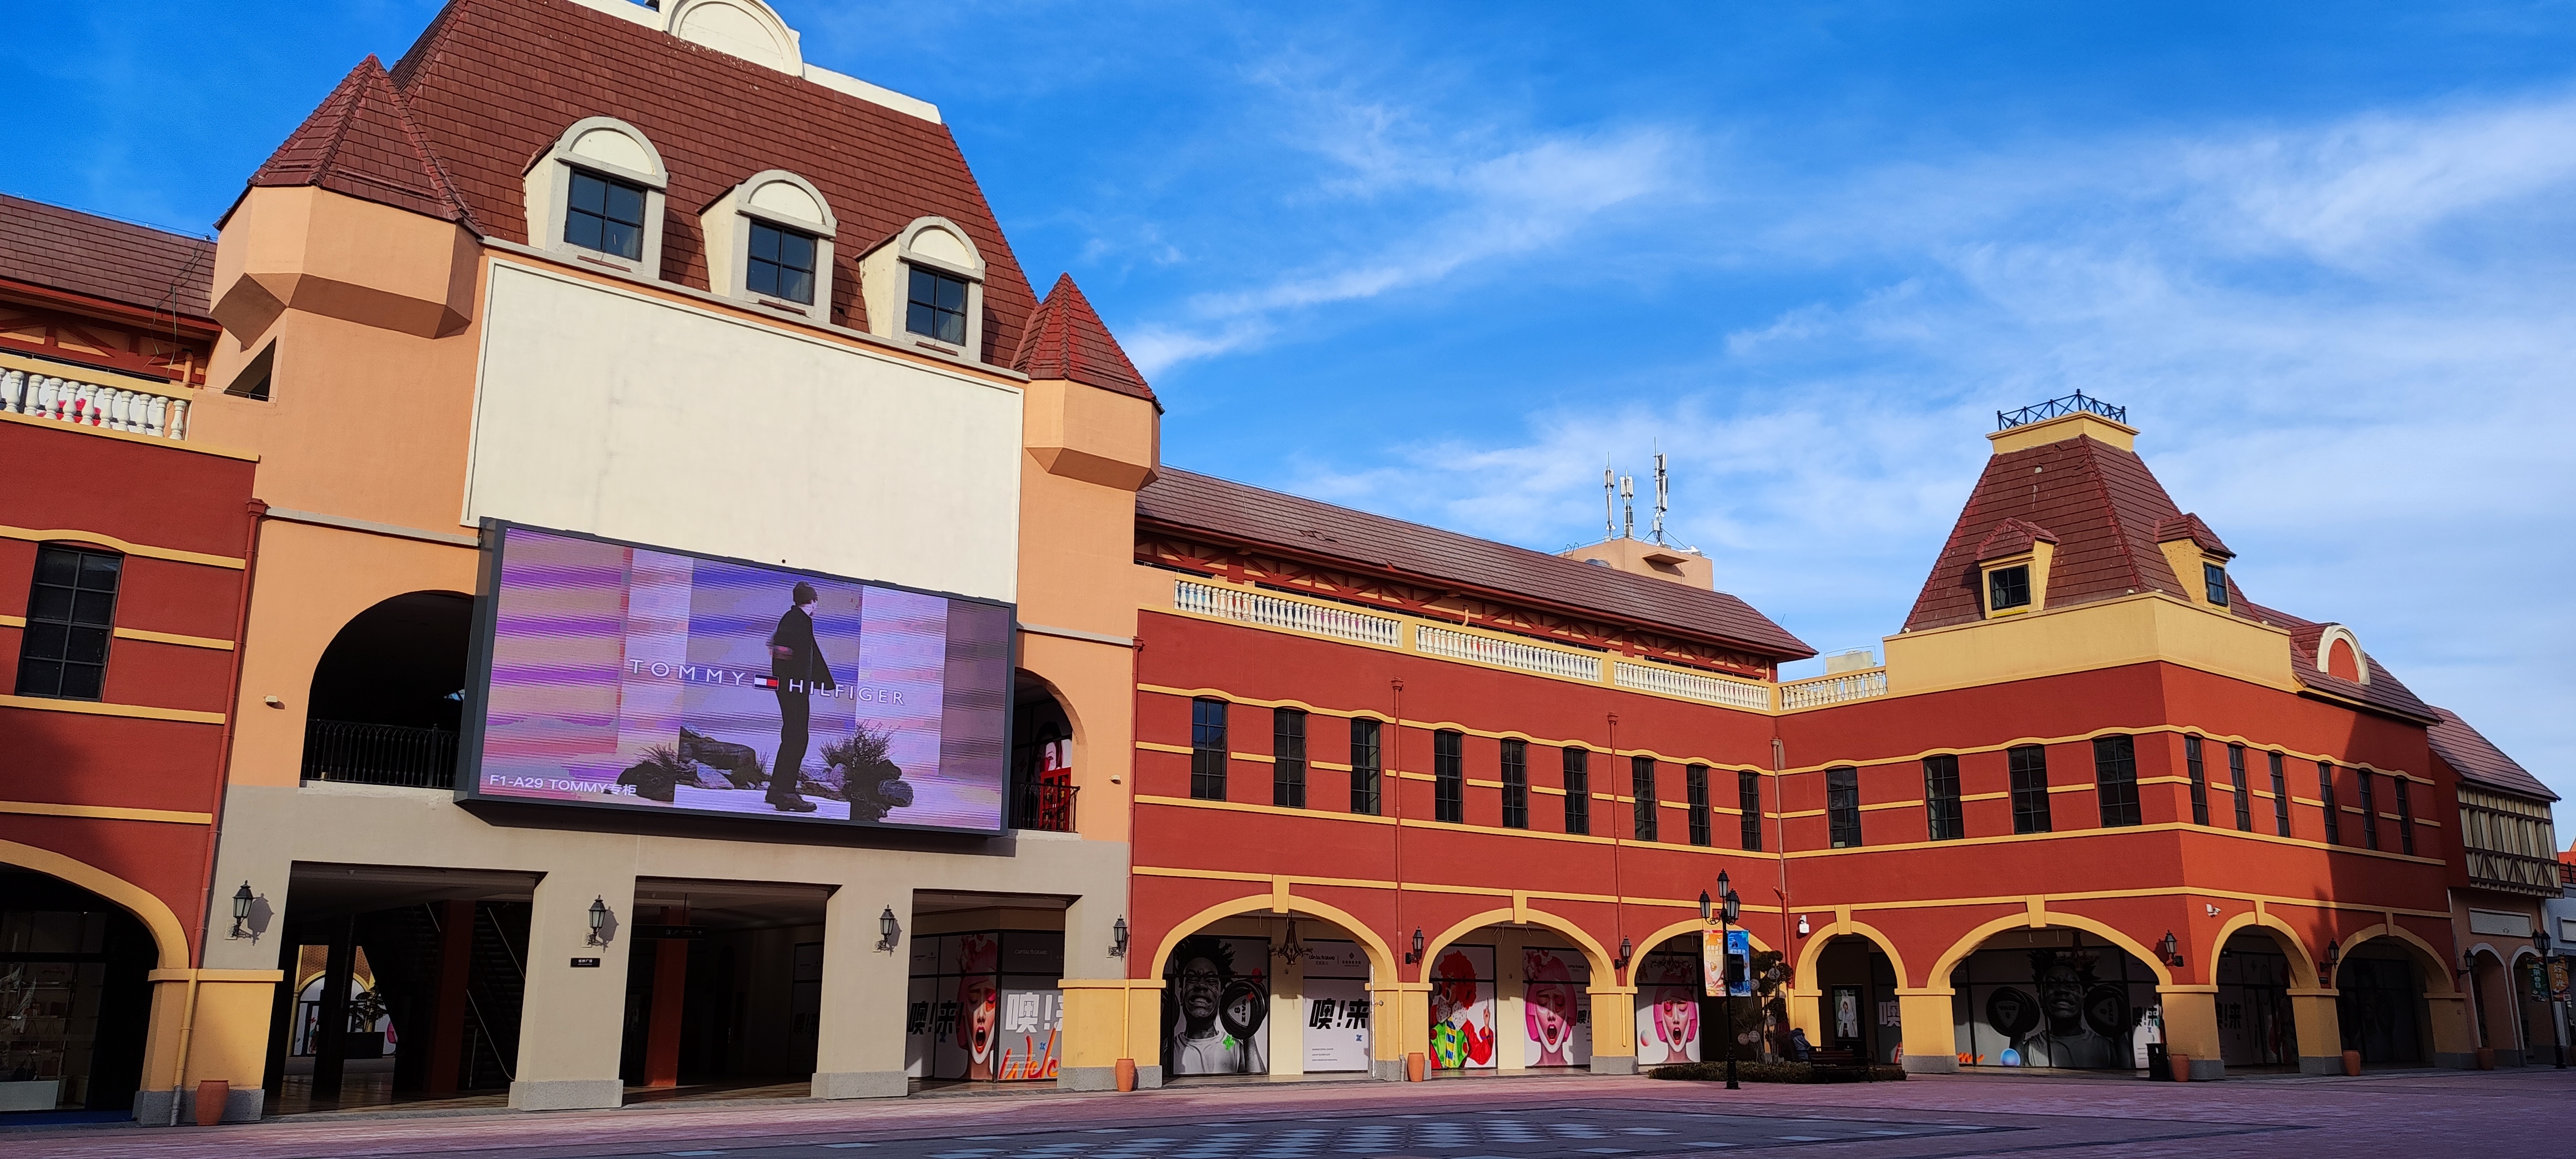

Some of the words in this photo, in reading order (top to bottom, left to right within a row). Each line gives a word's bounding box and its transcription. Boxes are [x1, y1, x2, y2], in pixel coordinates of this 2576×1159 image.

[629, 659, 746, 686] TOMMY
[789, 678, 904, 705] HILFIGER
[490, 774, 544, 788] F1-A29
[1309, 998, 1370, 1030] 噢!来
[1879, 1000, 1900, 1027] 噢
